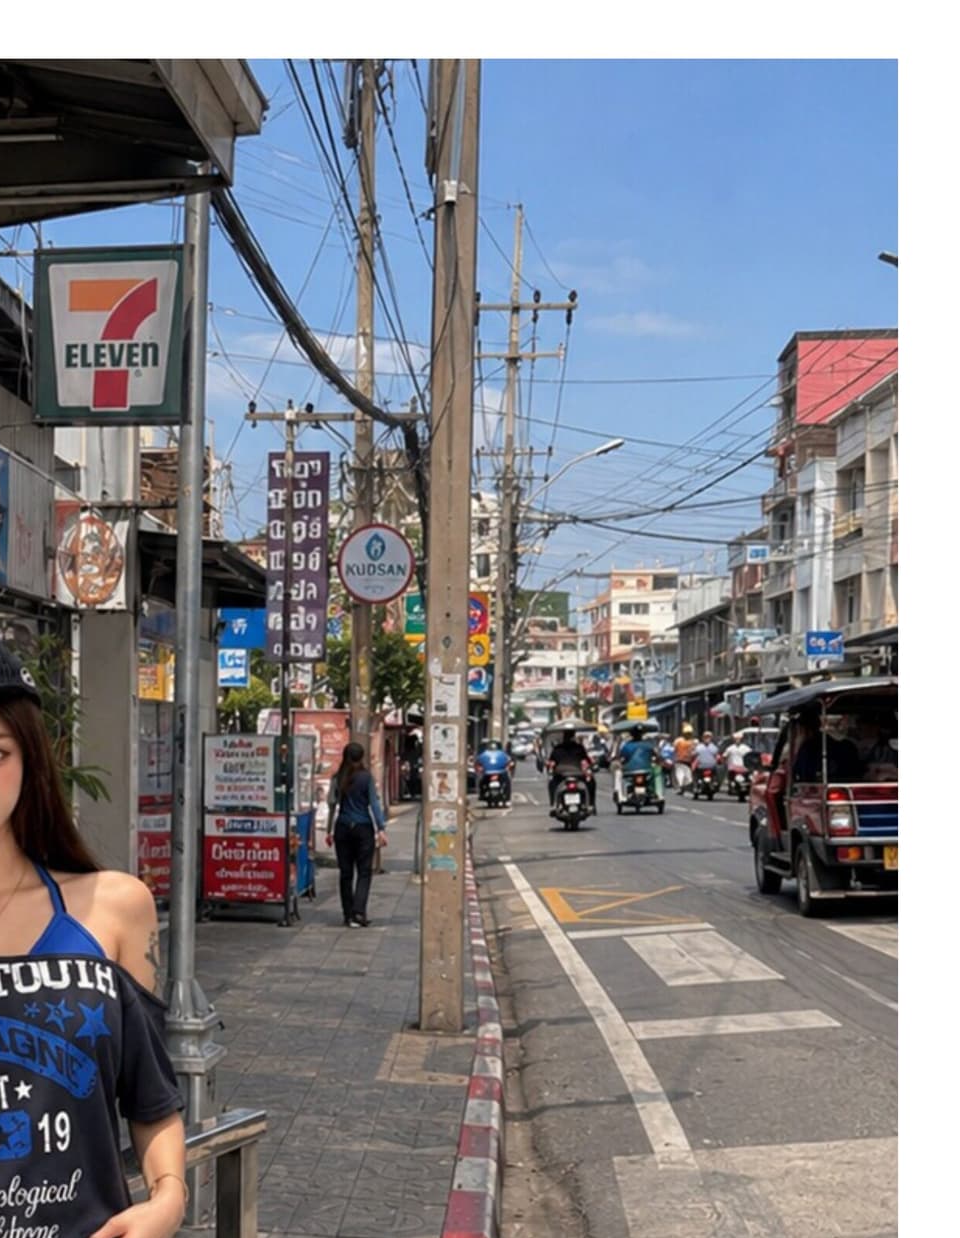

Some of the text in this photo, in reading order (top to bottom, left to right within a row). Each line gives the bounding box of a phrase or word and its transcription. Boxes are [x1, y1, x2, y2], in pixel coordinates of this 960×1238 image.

[68, 277, 158, 409] 7
[345, 562, 407, 577] KUDSAN
[37, 1110, 72, 1153] 19
